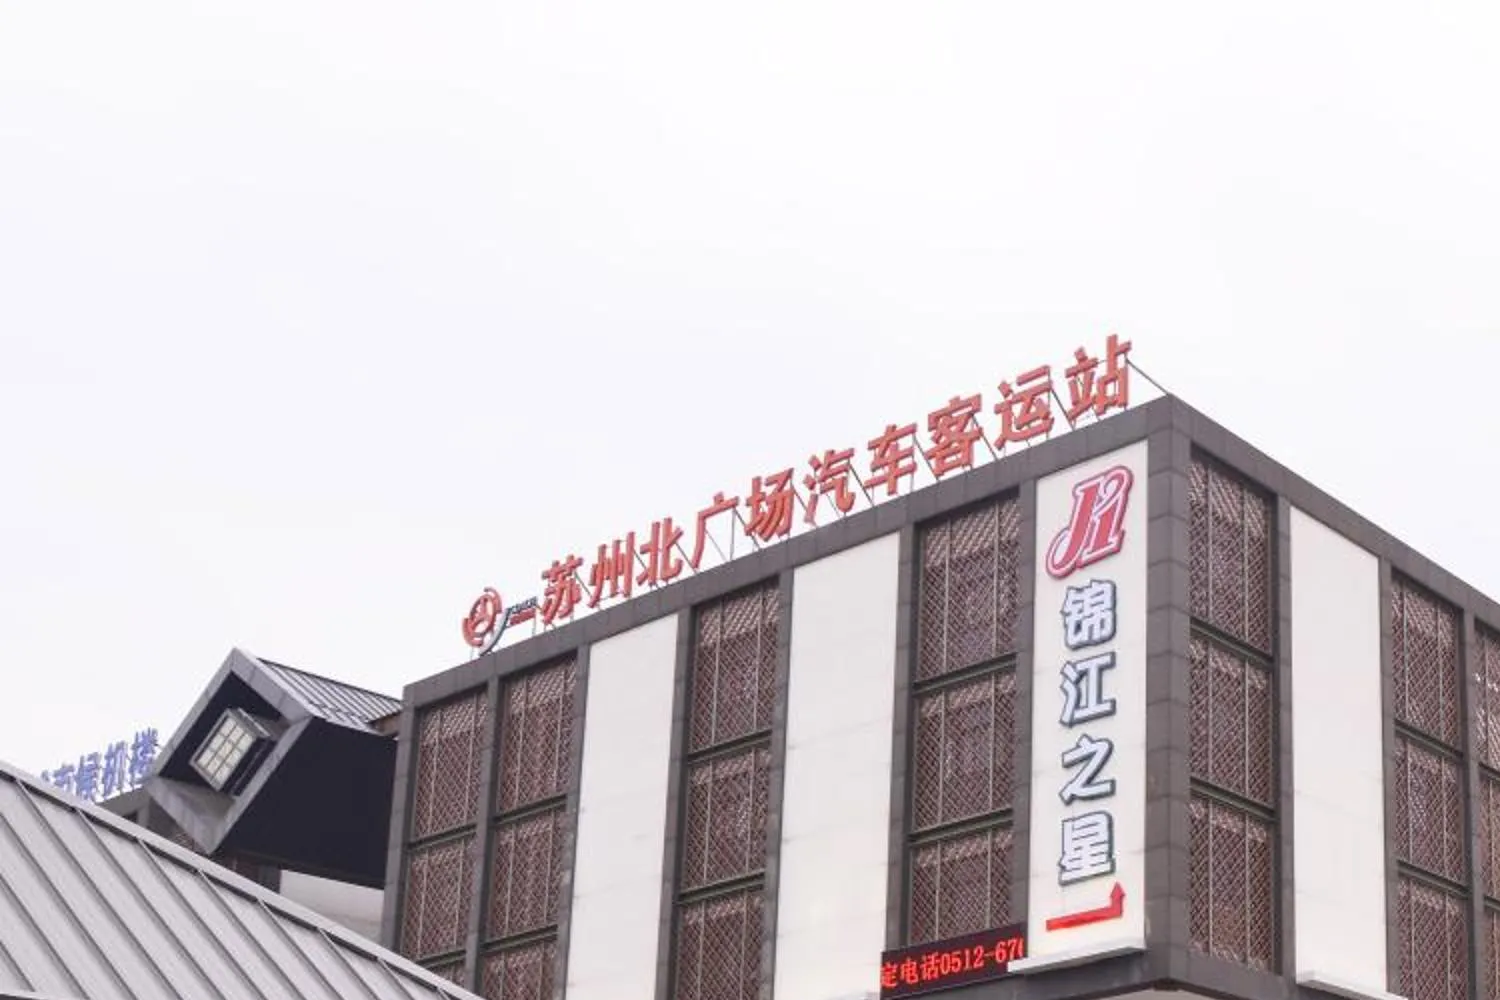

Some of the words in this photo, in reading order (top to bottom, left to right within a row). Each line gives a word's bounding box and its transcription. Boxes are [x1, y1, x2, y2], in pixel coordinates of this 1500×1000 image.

[541, 334, 1131, 624] 苏州北广场汽车客运站
[41, 726, 158, 801] 市候机楼
[1059, 578, 1117, 886] 锦江之星
